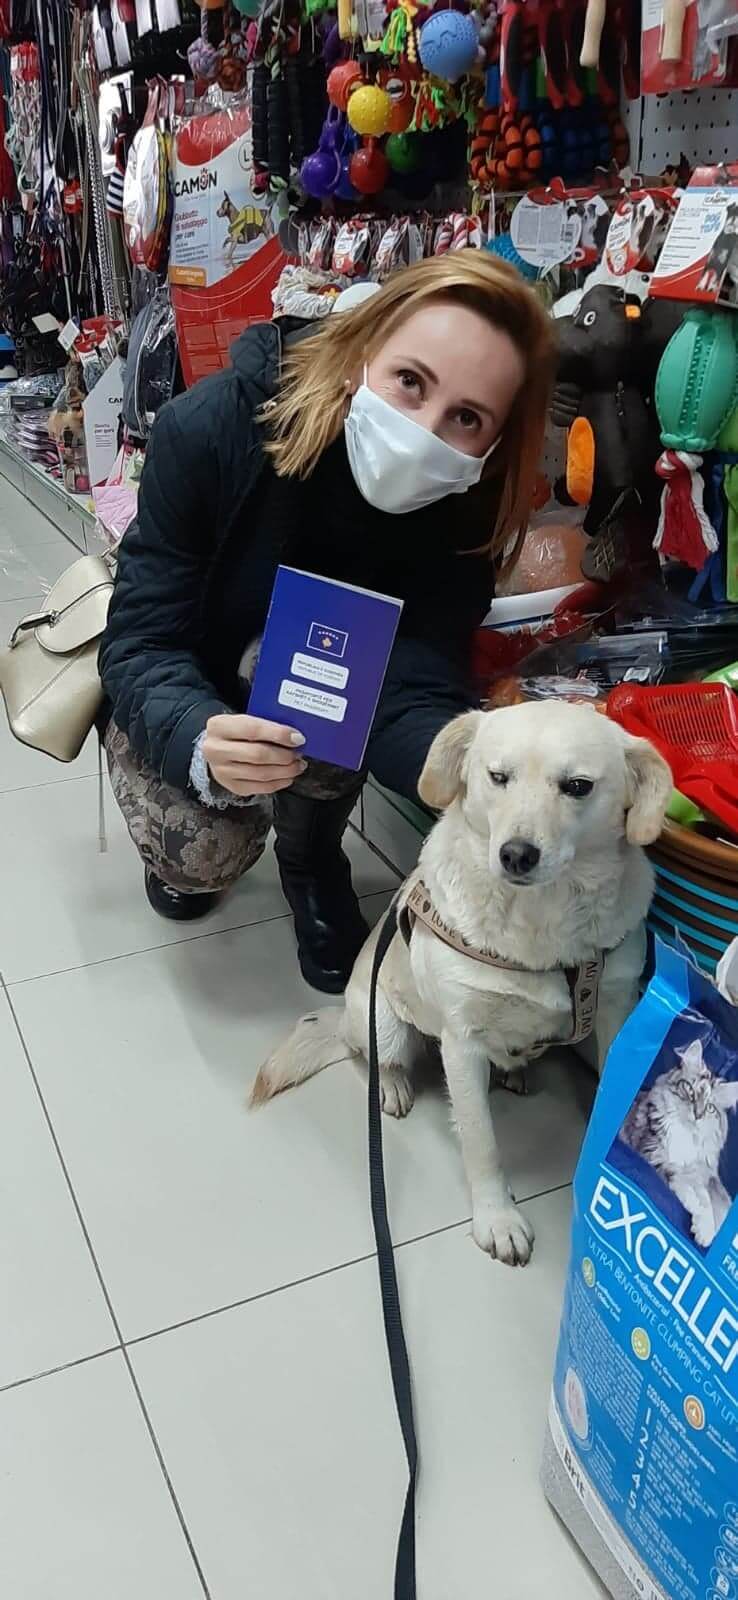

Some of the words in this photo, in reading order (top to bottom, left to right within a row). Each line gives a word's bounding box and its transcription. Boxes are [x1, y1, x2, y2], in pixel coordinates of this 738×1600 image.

[174, 171, 217, 197] CAMON
[431, 910, 457, 939] LOVE
[587, 1236, 613, 1271] ULTRA
[613, 1266, 658, 1327] BENTONITE
[657, 1323, 702, 1384] CLUMPING
[702, 1380, 722, 1408] CAT
[684, 1335, 712, 1371] Granules
[640, 1426, 648, 1450] 2
[635, 1448, 645, 1469] 3
[631, 1473, 641, 1490] 4
[628, 1489, 638, 1510] 5
